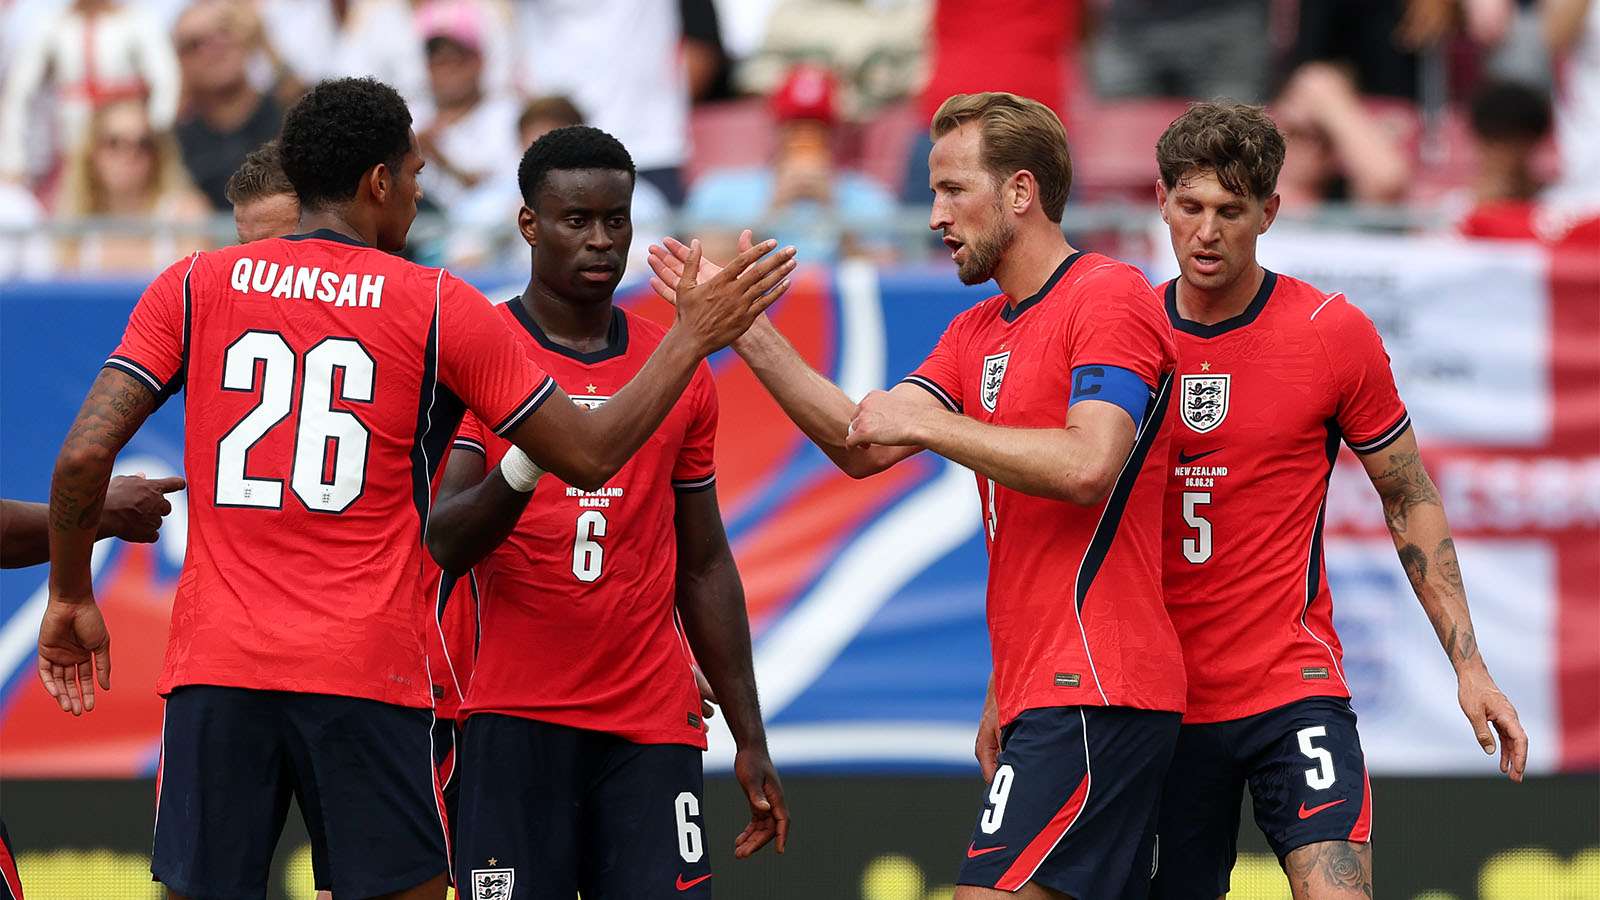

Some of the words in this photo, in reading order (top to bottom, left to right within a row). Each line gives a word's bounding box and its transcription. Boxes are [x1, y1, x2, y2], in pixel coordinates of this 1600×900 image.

[230, 257, 385, 309] QUANSAH
[1073, 367, 1105, 398] C
[214, 328, 377, 515] 26
[566, 487, 585, 497] NEW
[1174, 466, 1191, 476] NEW
[1191, 466, 1228, 476] ZEALAND
[572, 510, 607, 583] 6
[1182, 491, 1212, 565] 5
[1297, 725, 1336, 790] 5
[675, 791, 704, 863] 6
[981, 764, 1015, 835] 9
